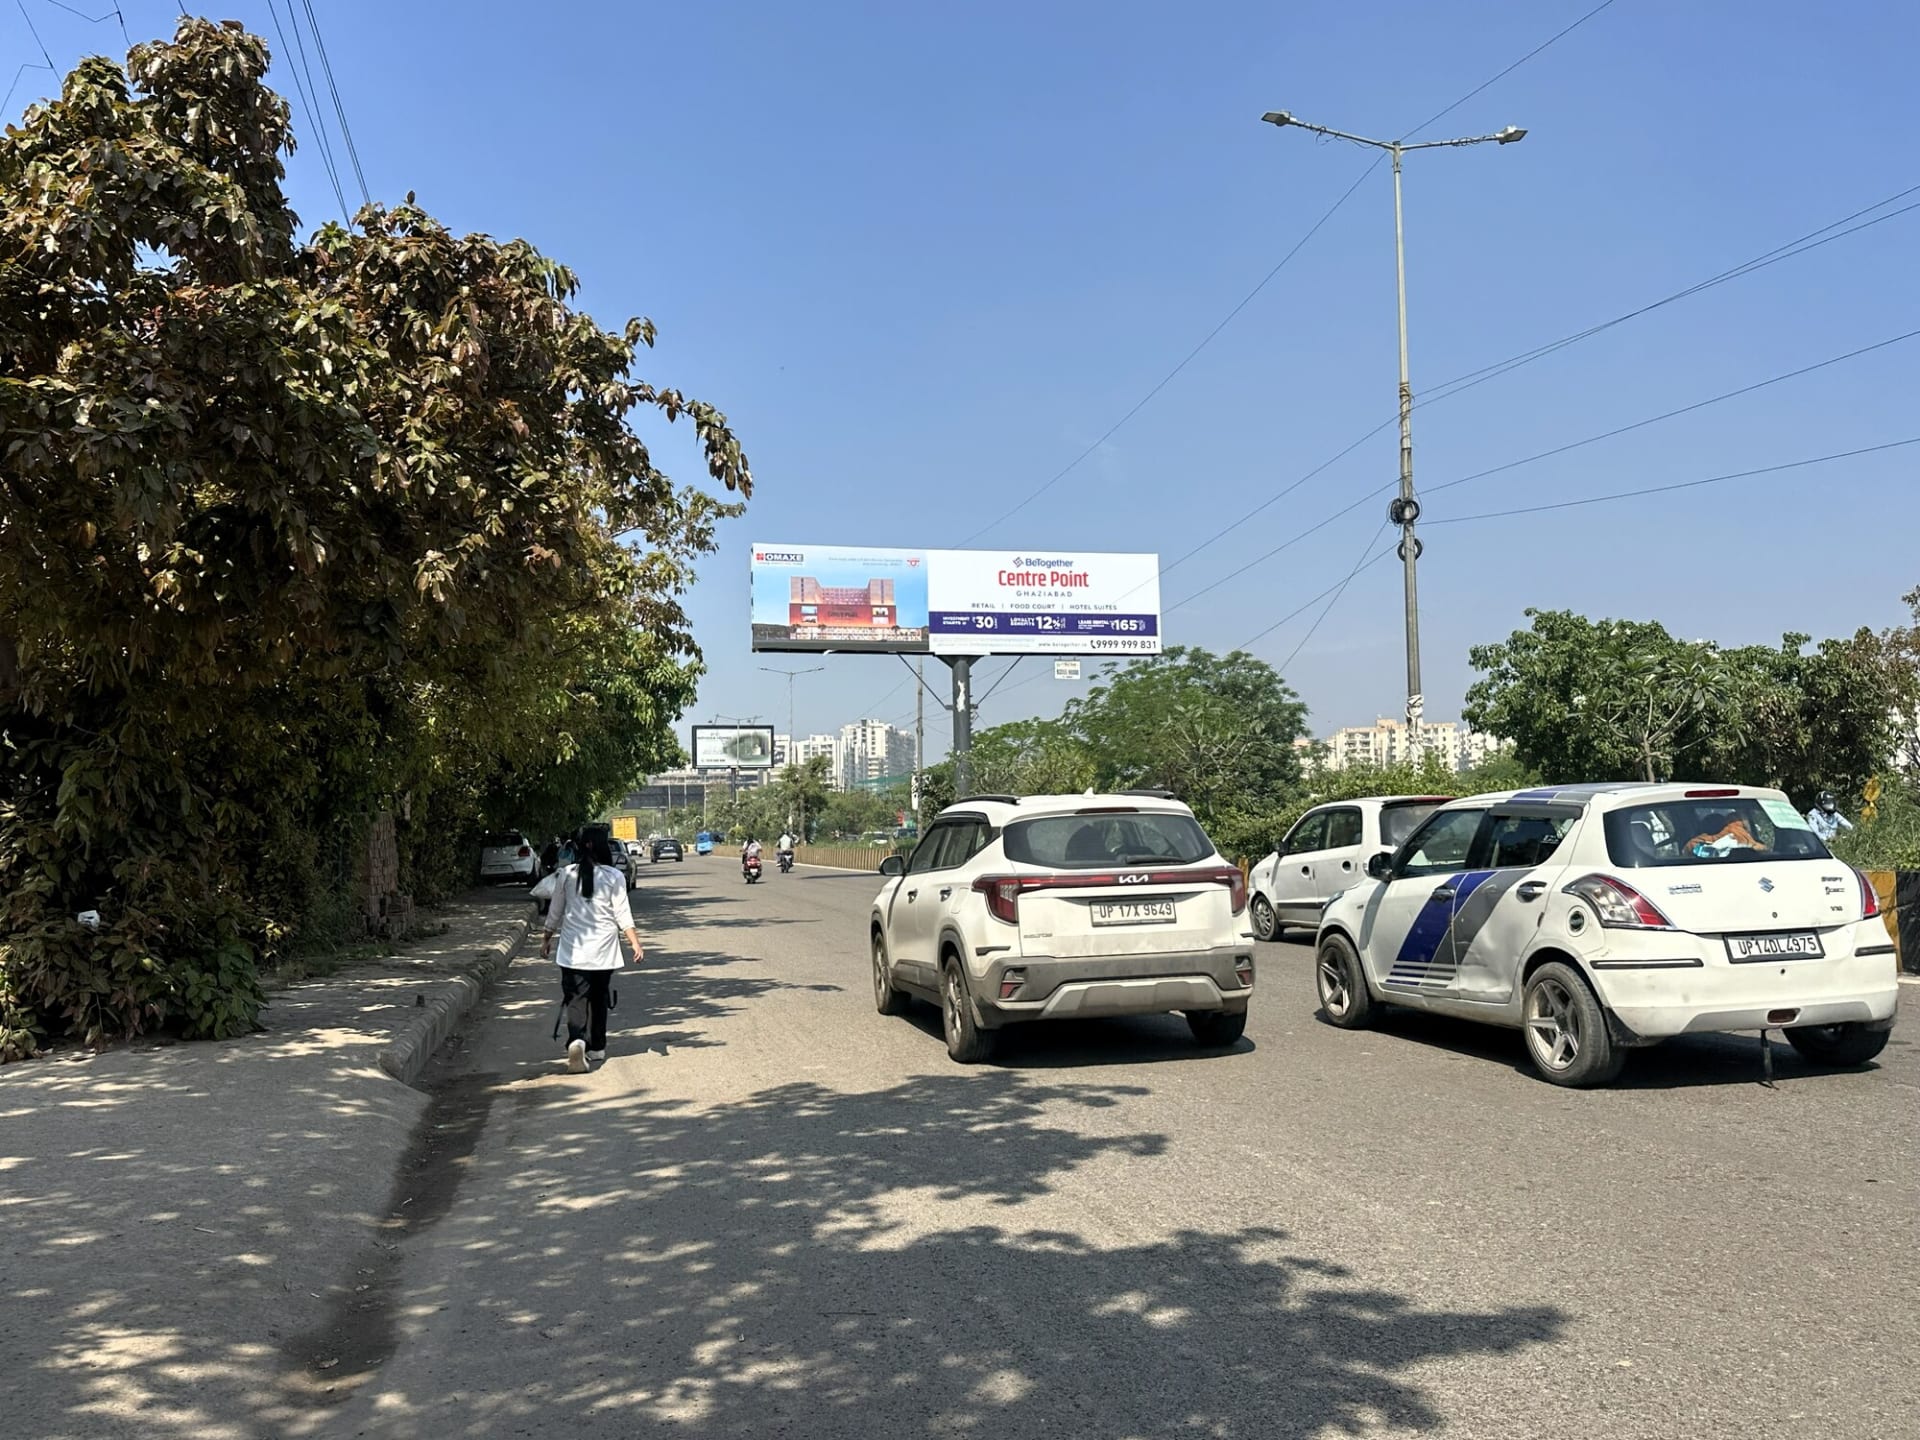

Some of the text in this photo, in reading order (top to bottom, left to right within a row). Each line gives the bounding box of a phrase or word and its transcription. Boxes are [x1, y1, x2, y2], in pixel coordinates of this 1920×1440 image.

[765, 553, 803, 561] OMAXE
[1025, 558, 1074, 568] BeTogether
[998, 570, 1089, 587] Centre Point
[1096, 639, 1156, 649] 9999 999 831
[1118, 874, 1149, 884] KIA
[1099, 904, 1114, 918] UP
[1143, 902, 1172, 916] 9649
